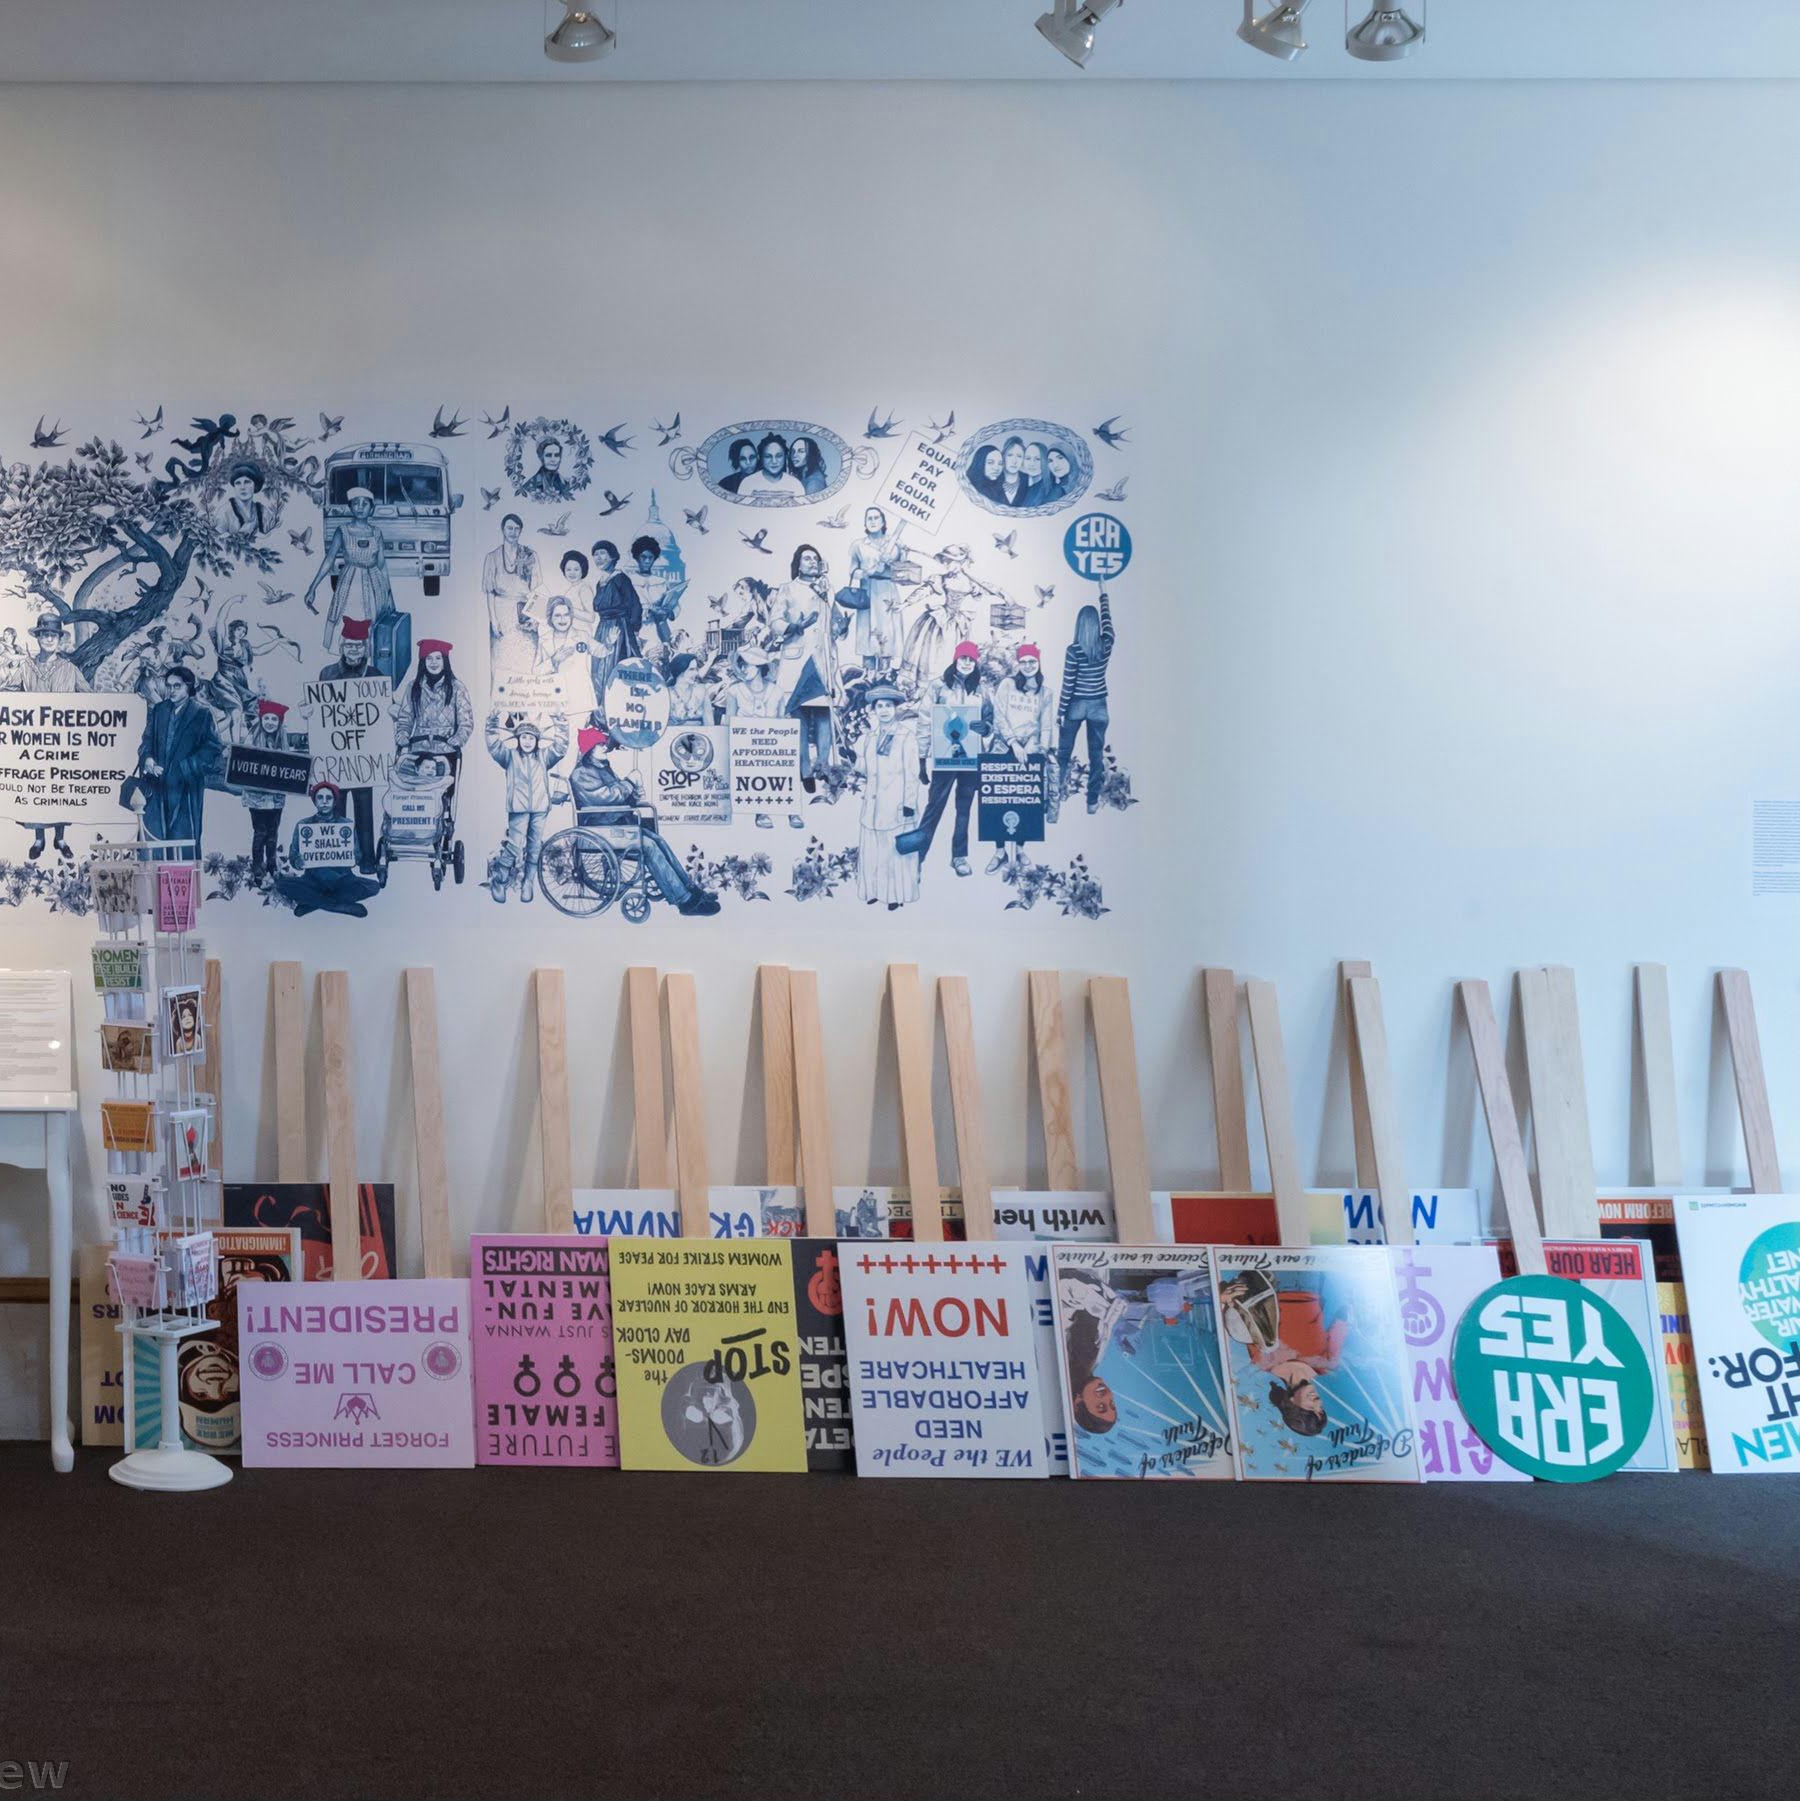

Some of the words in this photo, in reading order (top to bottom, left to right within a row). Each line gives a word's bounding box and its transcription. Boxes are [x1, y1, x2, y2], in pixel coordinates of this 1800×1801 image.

[917, 442, 958, 471] EQUAL
[919, 460, 944, 478] PAY
[911, 472, 937, 492] FOR
[896, 480, 936, 509] EQUAL
[889, 492, 931, 521] WORK!
[1075, 517, 1121, 548] ERA
[1073, 550, 1124, 575] YES
[307, 681, 347, 704] NOW
[355, 681, 390, 698] YOU'VE
[626, 703, 644, 713] NO
[40, 706, 127, 728] FREEDOM
[11, 730, 60, 745] WOMEN
[68, 731, 81, 746] IS
[88, 731, 117, 747] NOT
[331, 730, 366, 751] OFF
[19, 750, 30, 760] A
[34, 750, 80, 761] CRIME
[50, 767, 126, 780] PRISONERS
[237, 760, 258, 775] VOTE
[260, 765, 269, 776] IN
[271, 766, 276, 776] 8
[279, 766, 308, 781] YEARS
[981, 763, 1026, 771] RESPETA
[1029, 763, 1040, 771] MI
[736, 776, 792, 791] NOW!
[981, 774, 1041, 782] EXISTENCIA
[28, 784, 46, 793] NOT
[51, 784, 64, 793] BE
[69, 784, 111, 794] TREATED
[981, 785, 991, 794] O
[994, 785, 1041, 794] ESPERA
[15, 796, 28, 805] AS
[33, 797, 88, 806] CRIMINALS
[981, 796, 1041, 804] RESISTENCIA
[320, 825, 335, 836] WE
[314, 839, 341, 848] SHALL
[303, 850, 353, 861] OVERCOME!
[111, 1184, 126, 1192] NO
[1043, 1208, 1106, 1232] with
[484, 1250, 555, 1272] RIGHTS
[619, 1252, 654, 1264] PEACE
[657, 1252, 679, 1264] FOR
[681, 1252, 724, 1265] STRIKE
[1056, 1251, 1109, 1268] Future
[1114, 1251, 1138, 1262] our
[1157, 1251, 1209, 1268] Science
[1219, 1251, 1272, 1269] Future
[1550, 1252, 1585, 1273] OUR
[1589, 1252, 1636, 1275] HEAR
[647, 1283, 681, 1295] NOW!
[685, 1283, 718, 1296] RACE
[722, 1284, 757, 1296] ARMS
[617, 1301, 671, 1313] NUCLEAR
[674, 1301, 688, 1313] OF
[698, 1301, 740, 1313] HORROR
[744, 1302, 764, 1314] THE
[767, 1303, 789, 1314] END
[246, 1305, 459, 1333] PRESIDENT!
[868, 1297, 1009, 1337] NOW!
[485, 1324, 550, 1337] WANNA
[558, 1325, 595, 1338] JUST
[617, 1328, 661, 1342] CLOCK
[665, 1329, 691, 1344] DAY
[1479, 1294, 1626, 1368] YES
[625, 1349, 685, 1364] DOOMS-
[704, 1341, 792, 1383] STOP
[295, 1363, 335, 1384] ME
[343, 1363, 415, 1384] CALL
[644, 1369, 668, 1385] the
[859, 1360, 1026, 1380] HEALTHCARE
[862, 1390, 1029, 1410] AFFORDABLE
[487, 1404, 606, 1426] FEMALE
[1493, 1370, 1625, 1466] ERA
[915, 1419, 983, 1438] NEED
[266, 1432, 365, 1448] PRINCESS
[370, 1432, 449, 1448] FORGET
[489, 1434, 589, 1456] FUTURE
[873, 1447, 945, 1467] People
[955, 1448, 988, 1466] the
[996, 1449, 1033, 1467] WE
